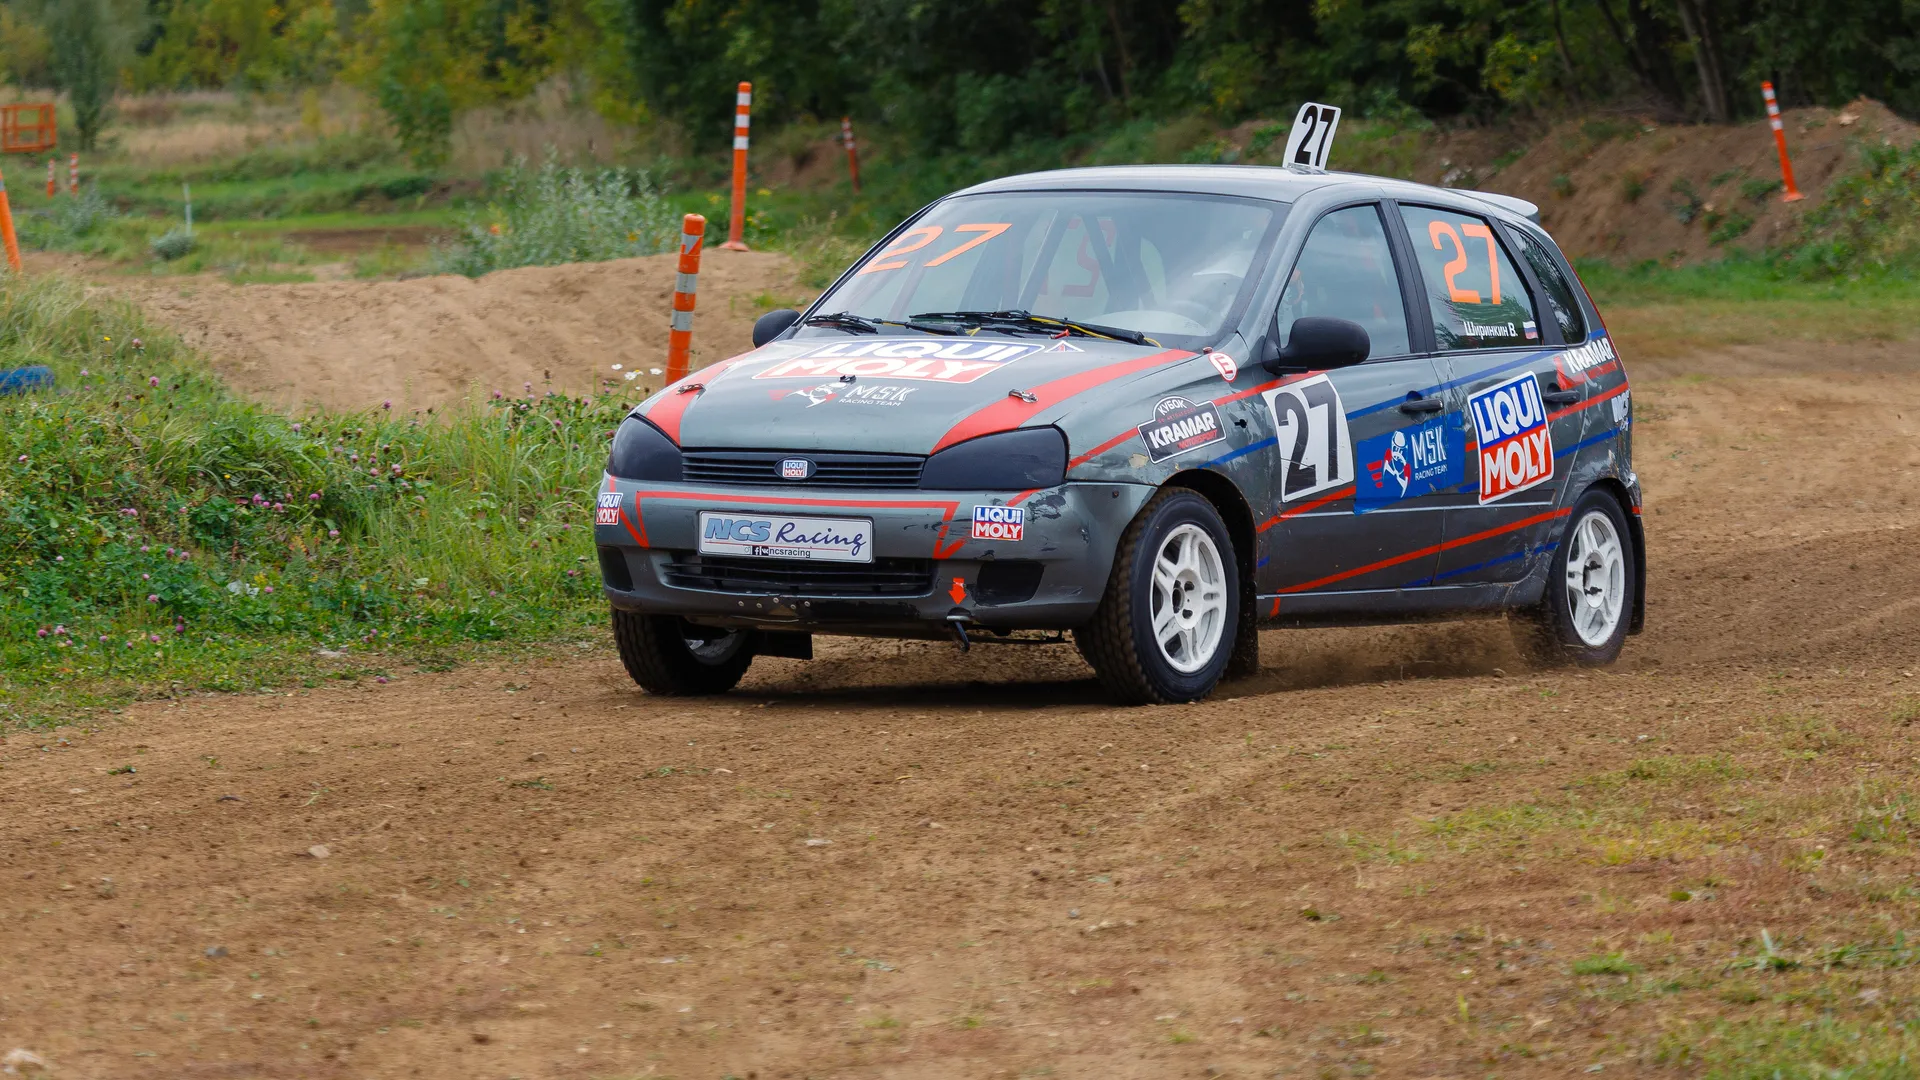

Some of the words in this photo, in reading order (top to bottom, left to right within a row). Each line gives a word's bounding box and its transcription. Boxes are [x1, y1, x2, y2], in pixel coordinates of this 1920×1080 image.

[1294, 105, 1337, 166] 27
[857, 223, 1012, 275] 27
[1428, 221, 1501, 304] 27
[1463, 321, 1508, 339] Ширинкин
[767, 357, 997, 380] MOLY
[810, 341, 1028, 361] LIQUI
[1563, 338, 1615, 373] KRAMAR
[845, 385, 919, 401] MSK
[1157, 399, 1187, 416] КУБОК
[1148, 411, 1216, 449] KRAMAR
[1473, 380, 1542, 444] LIQUI
[1274, 380, 1339, 496] 27
[1411, 425, 1447, 469] MSK
[1414, 468, 1435, 481] RACING
[1434, 464, 1448, 475] TEAM
[1484, 429, 1547, 495] MOLY
[976, 507, 1021, 523] LIQUI
[976, 522, 1021, 538] MOLY
[704, 518, 772, 542] NCS
[775, 522, 867, 556] Racing
